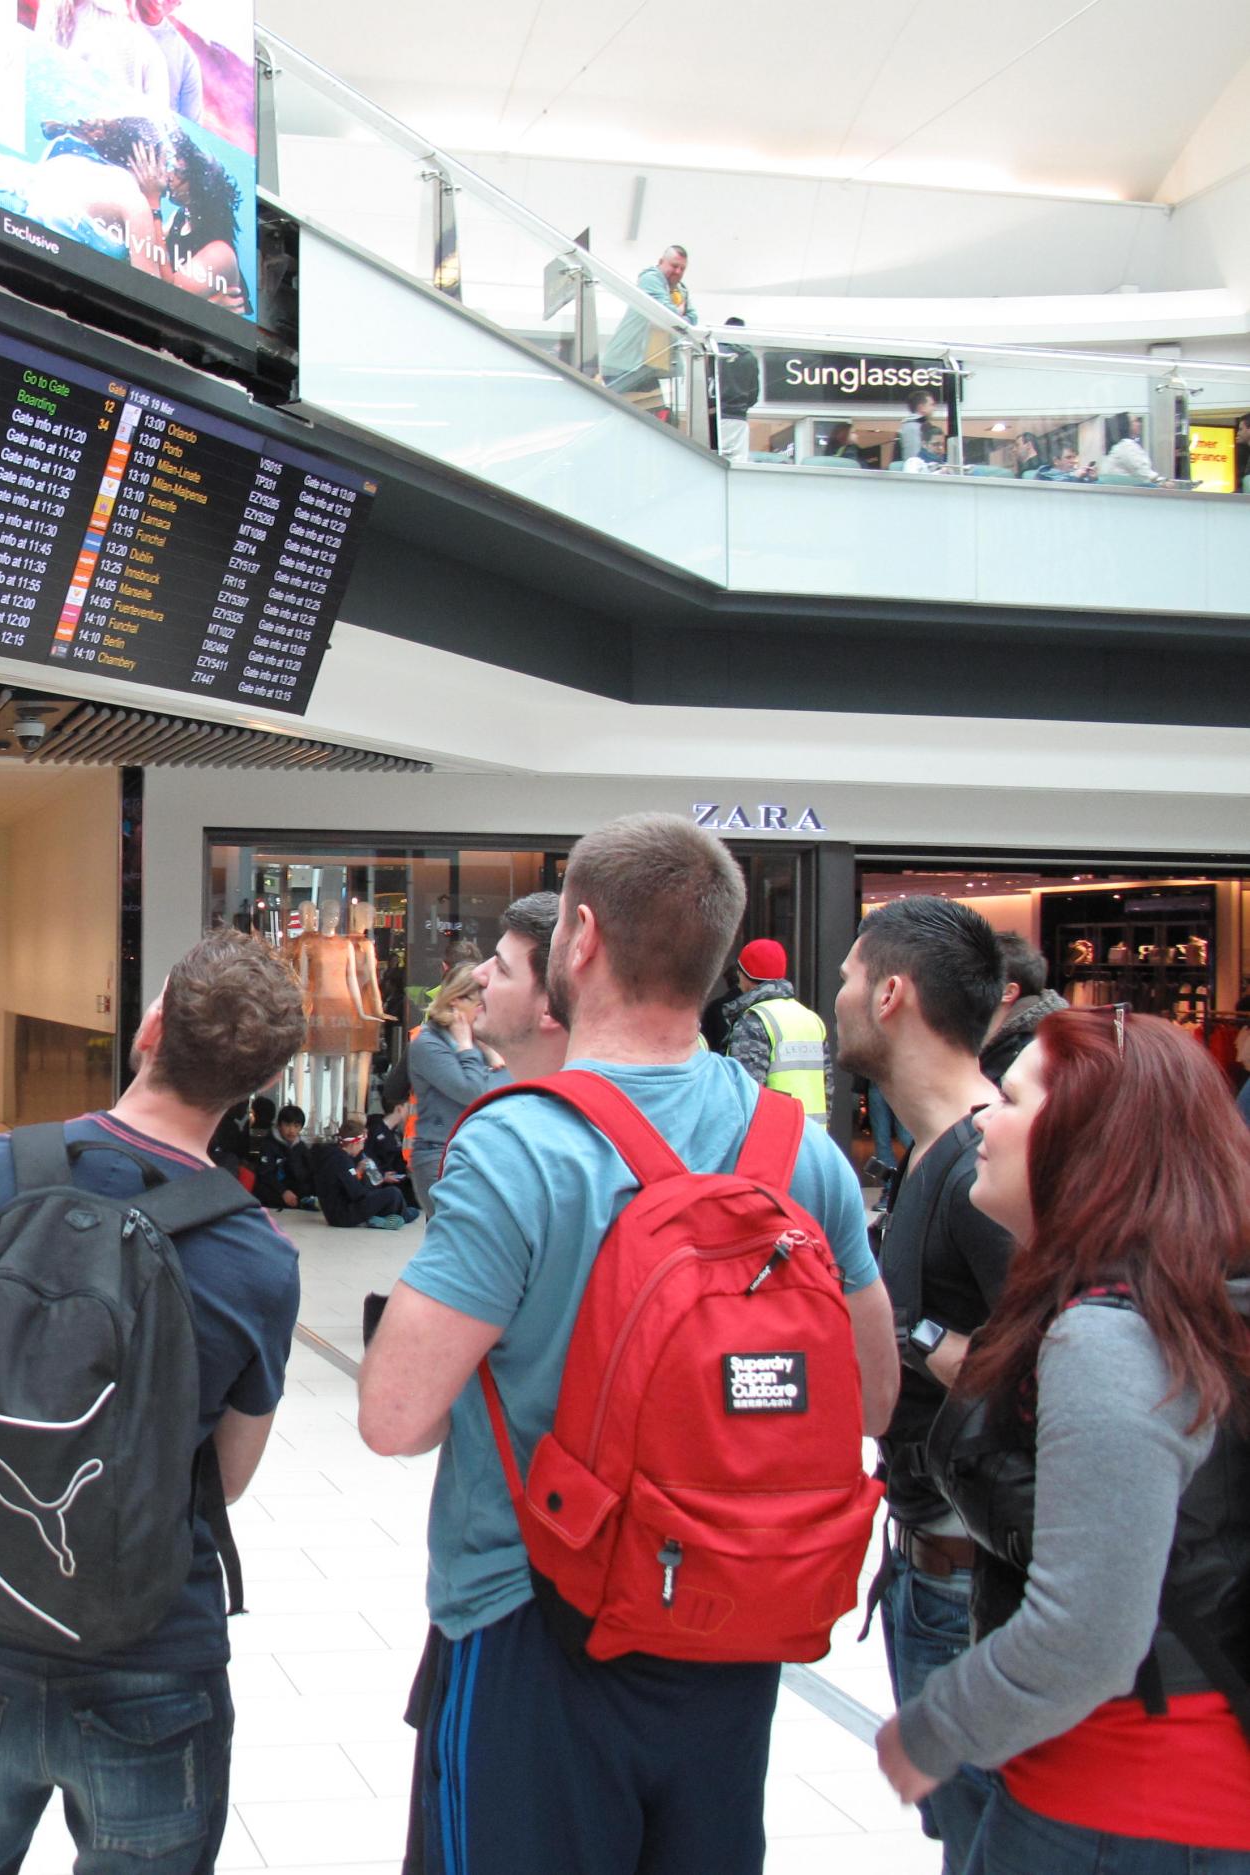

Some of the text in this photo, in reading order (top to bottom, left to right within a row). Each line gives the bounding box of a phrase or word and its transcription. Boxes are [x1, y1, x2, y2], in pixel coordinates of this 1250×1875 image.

[4, 219, 60, 255] Exclusive
[91, 216, 166, 266] calvin
[174, 244, 228, 294] klein
[23, 370, 37, 385] Go
[37, 376, 48, 389] to
[48, 379, 70, 397] Gate
[104, 399, 115, 413] 12
[786, 359, 943, 393] Sunglasses
[11, 408, 34, 426] Gate
[34, 416, 52, 432] info
[51, 424, 62, 436] at
[63, 426, 87, 444] 11:20
[16, 388, 57, 416] Boarding
[97, 418, 110, 431] 34
[693, 803, 828, 832] ZARA
[730, 1356, 793, 1373] Superdry
[731, 1370, 777, 1384] Japan
